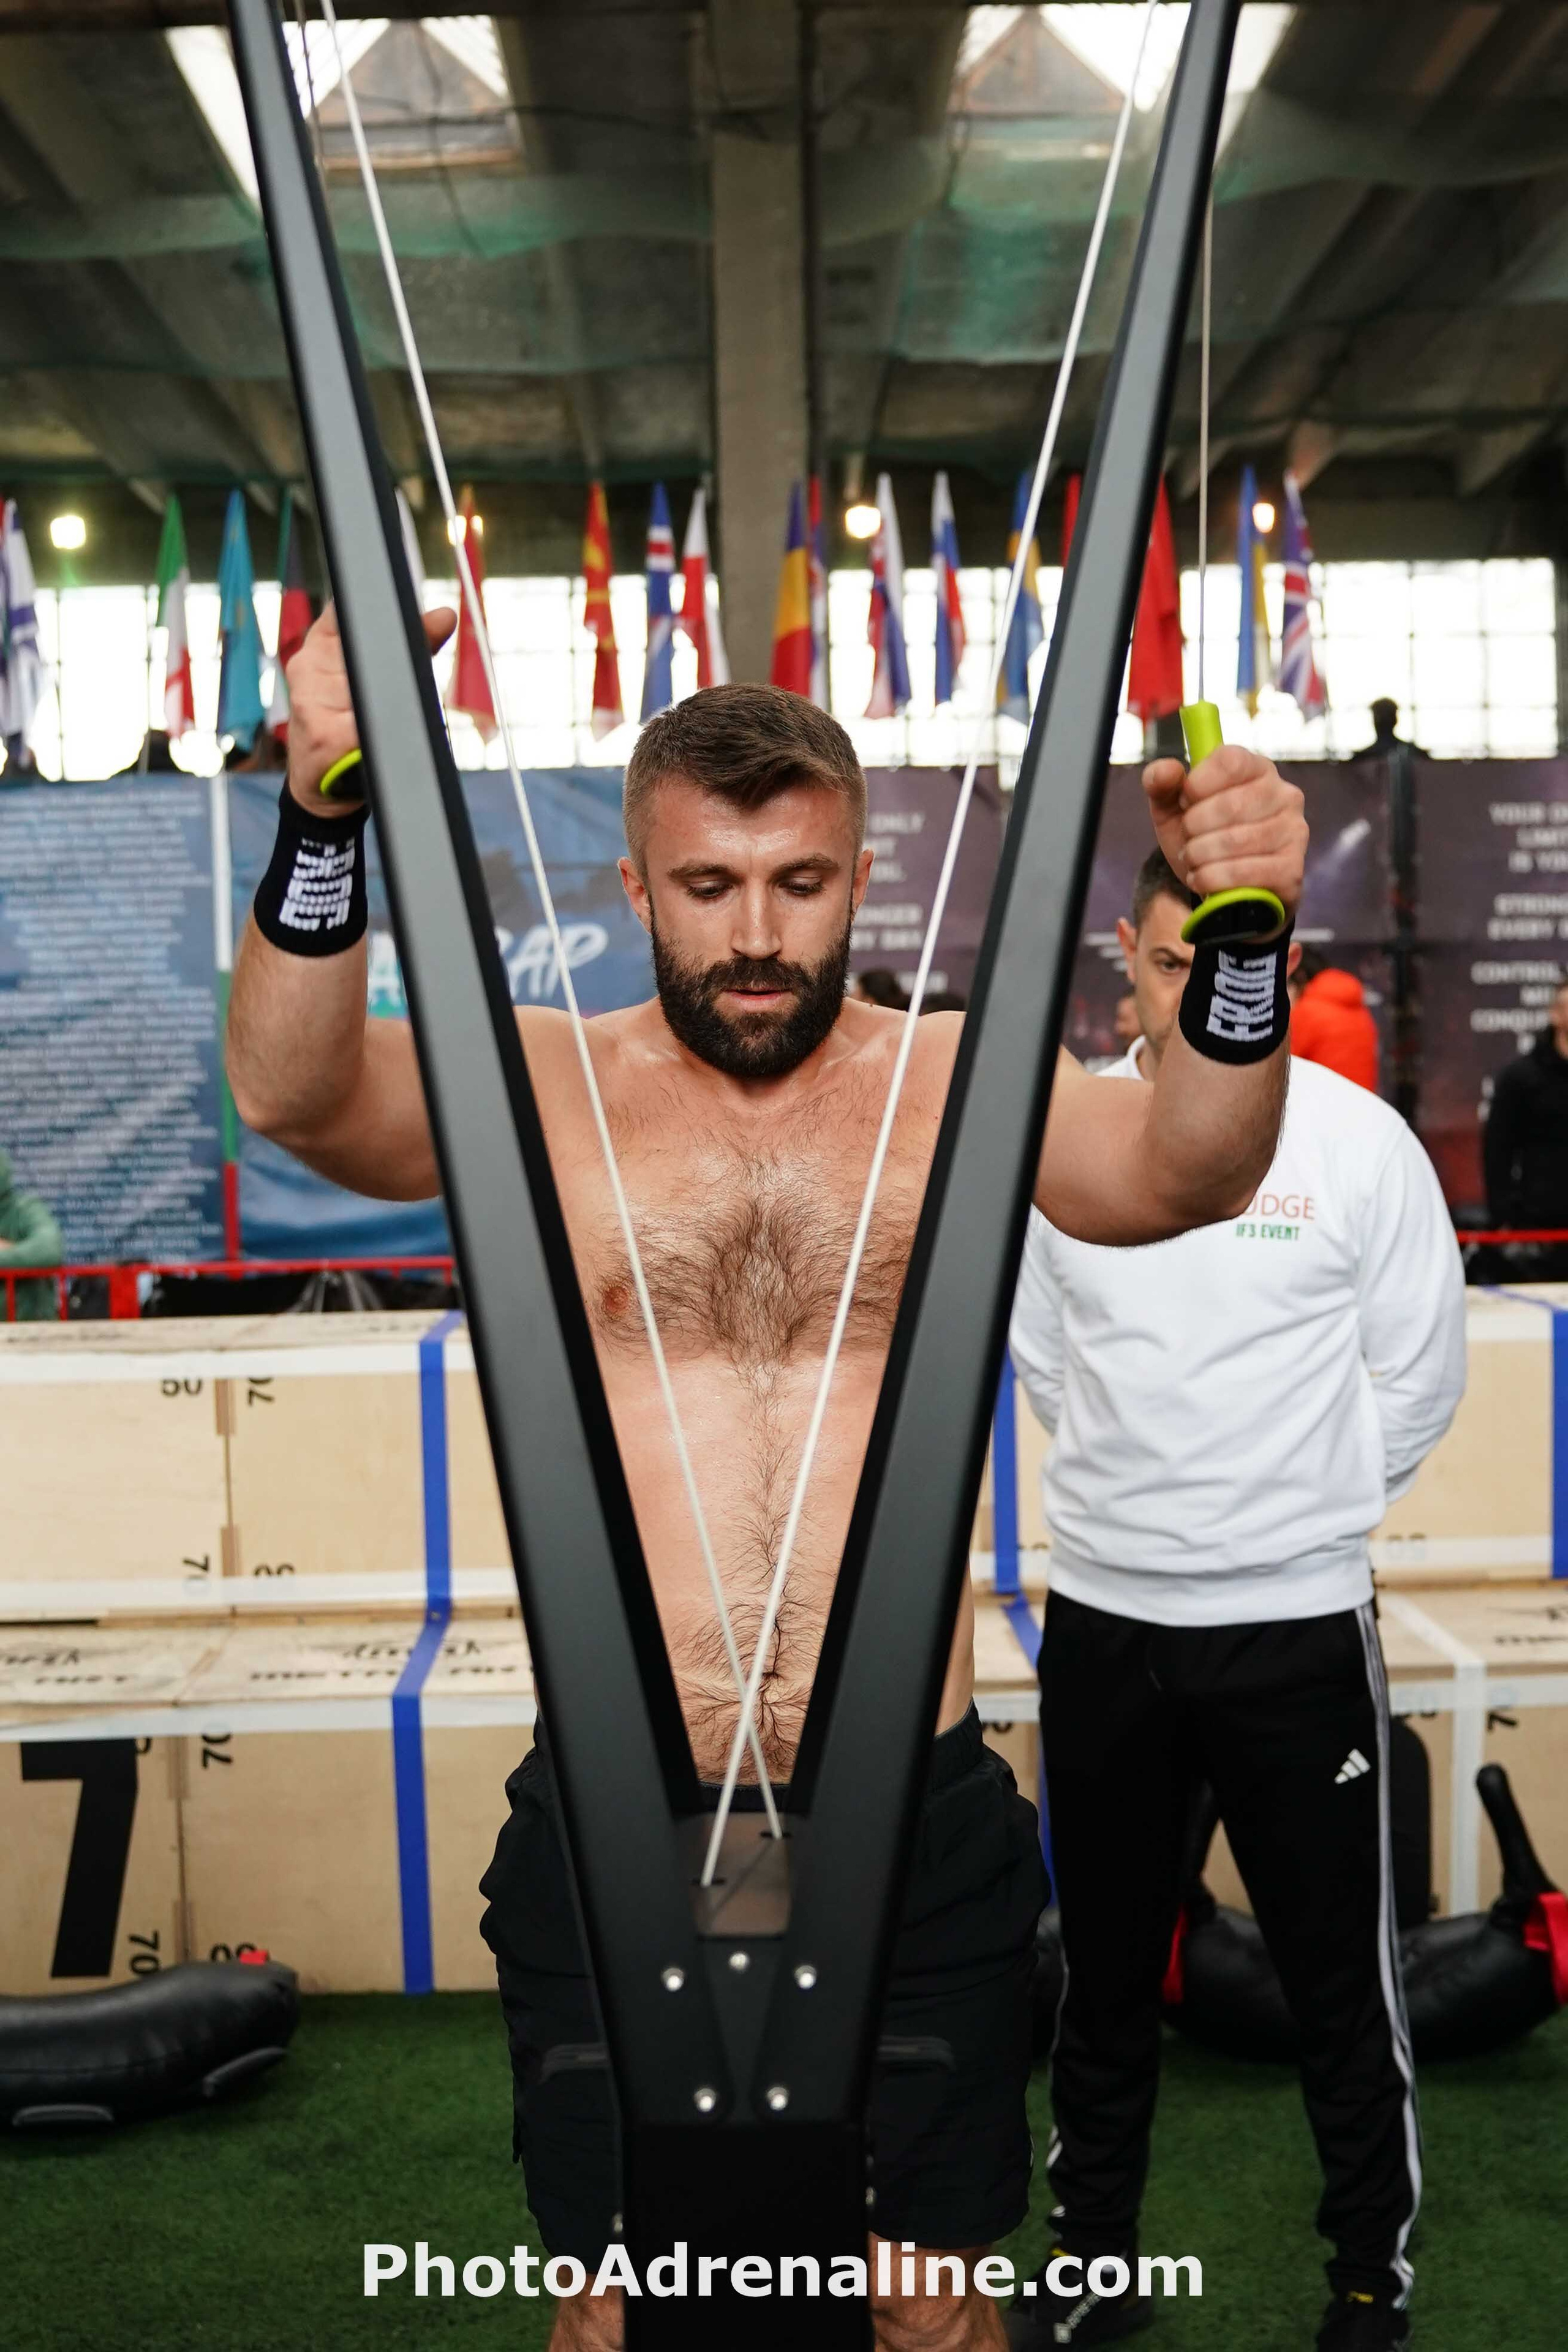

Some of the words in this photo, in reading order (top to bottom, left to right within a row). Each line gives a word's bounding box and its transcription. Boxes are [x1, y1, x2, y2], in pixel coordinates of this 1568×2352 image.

[1206, 949, 1278, 1042] FROG
[21, 1741, 138, 1978] 7
[127, 1930, 160, 1975] 70
